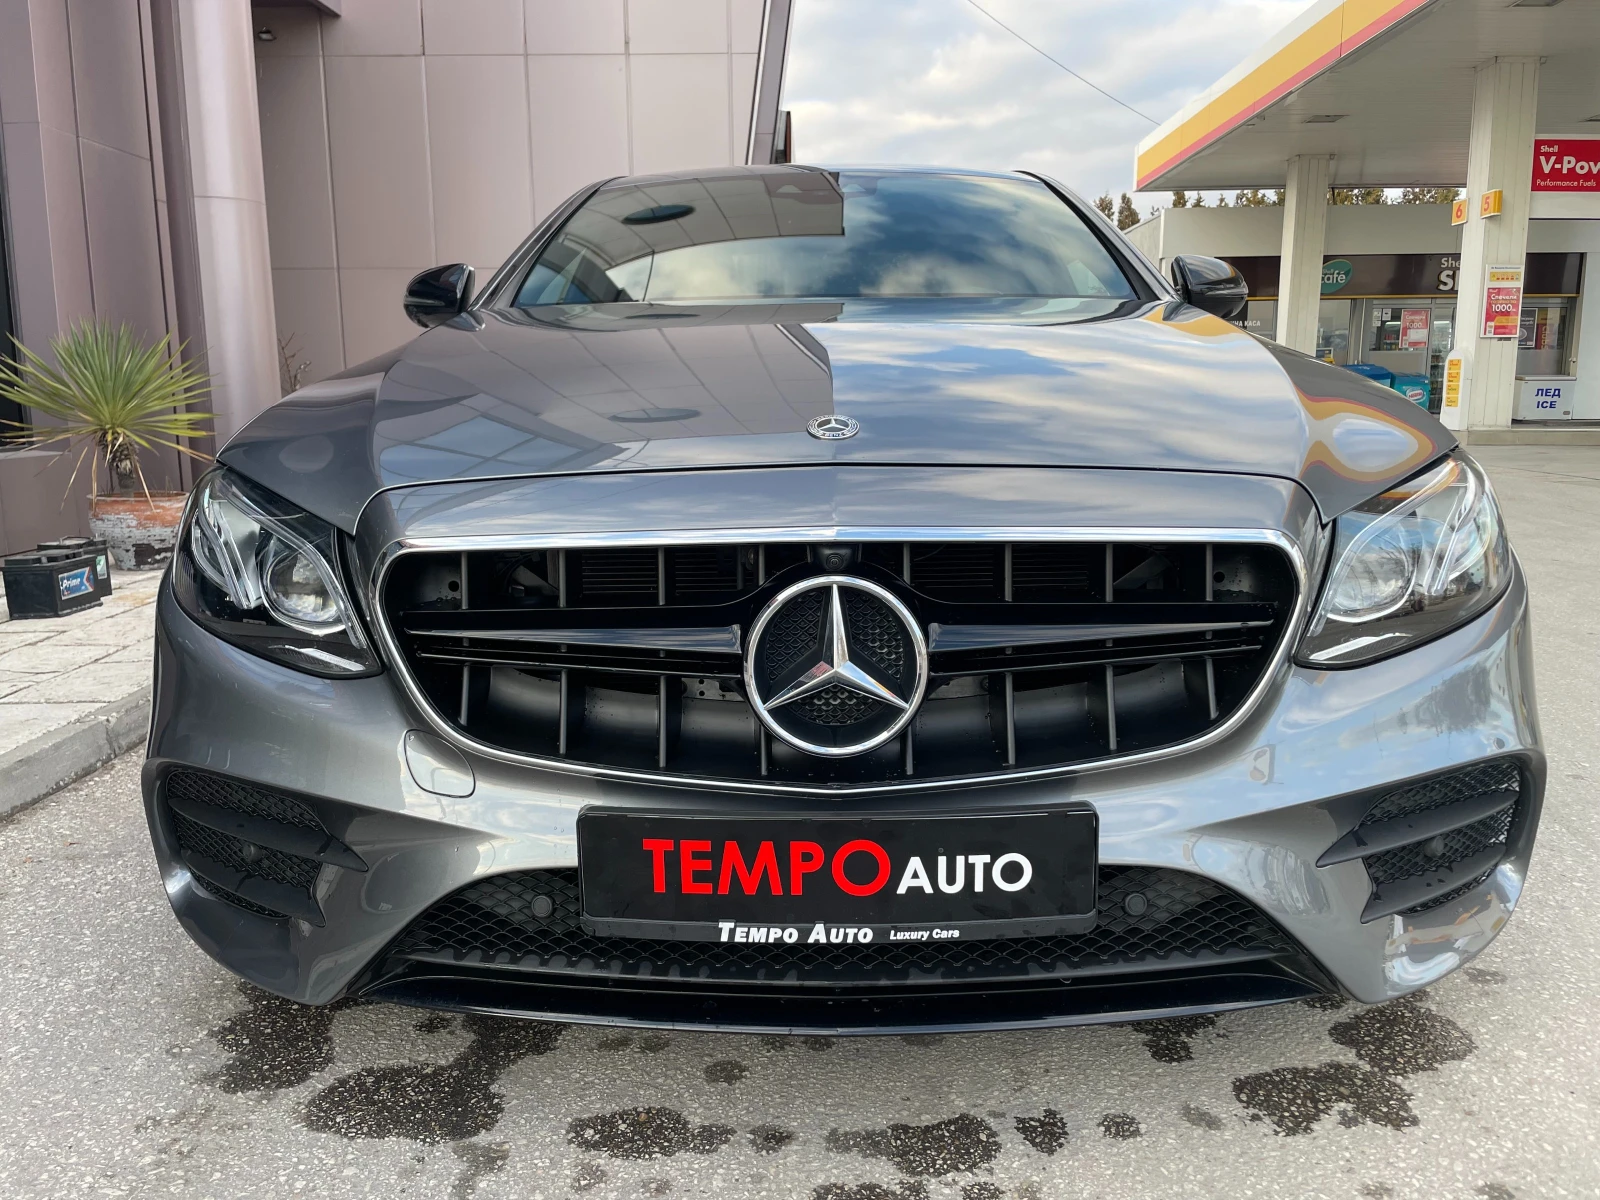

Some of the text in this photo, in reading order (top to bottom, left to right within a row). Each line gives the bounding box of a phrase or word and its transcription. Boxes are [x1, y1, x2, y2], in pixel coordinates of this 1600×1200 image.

[1539, 156, 1600, 175] V-Pow
[1536, 179, 1596, 187] Performance Fuels
[1483, 196, 1490, 212] 5
[1455, 203, 1463, 219] 6
[1440, 257, 1460, 268] She
[1492, 304, 1513, 312] 1000
[1535, 388, 1561, 398] ЛЕД
[1536, 401, 1557, 409] ICE
[63, 577, 81, 587] Prime
[643, 838, 1033, 897] TEMPO AUTO
[889, 930, 930, 941] Luxury
[932, 928, 960, 939] Cars
